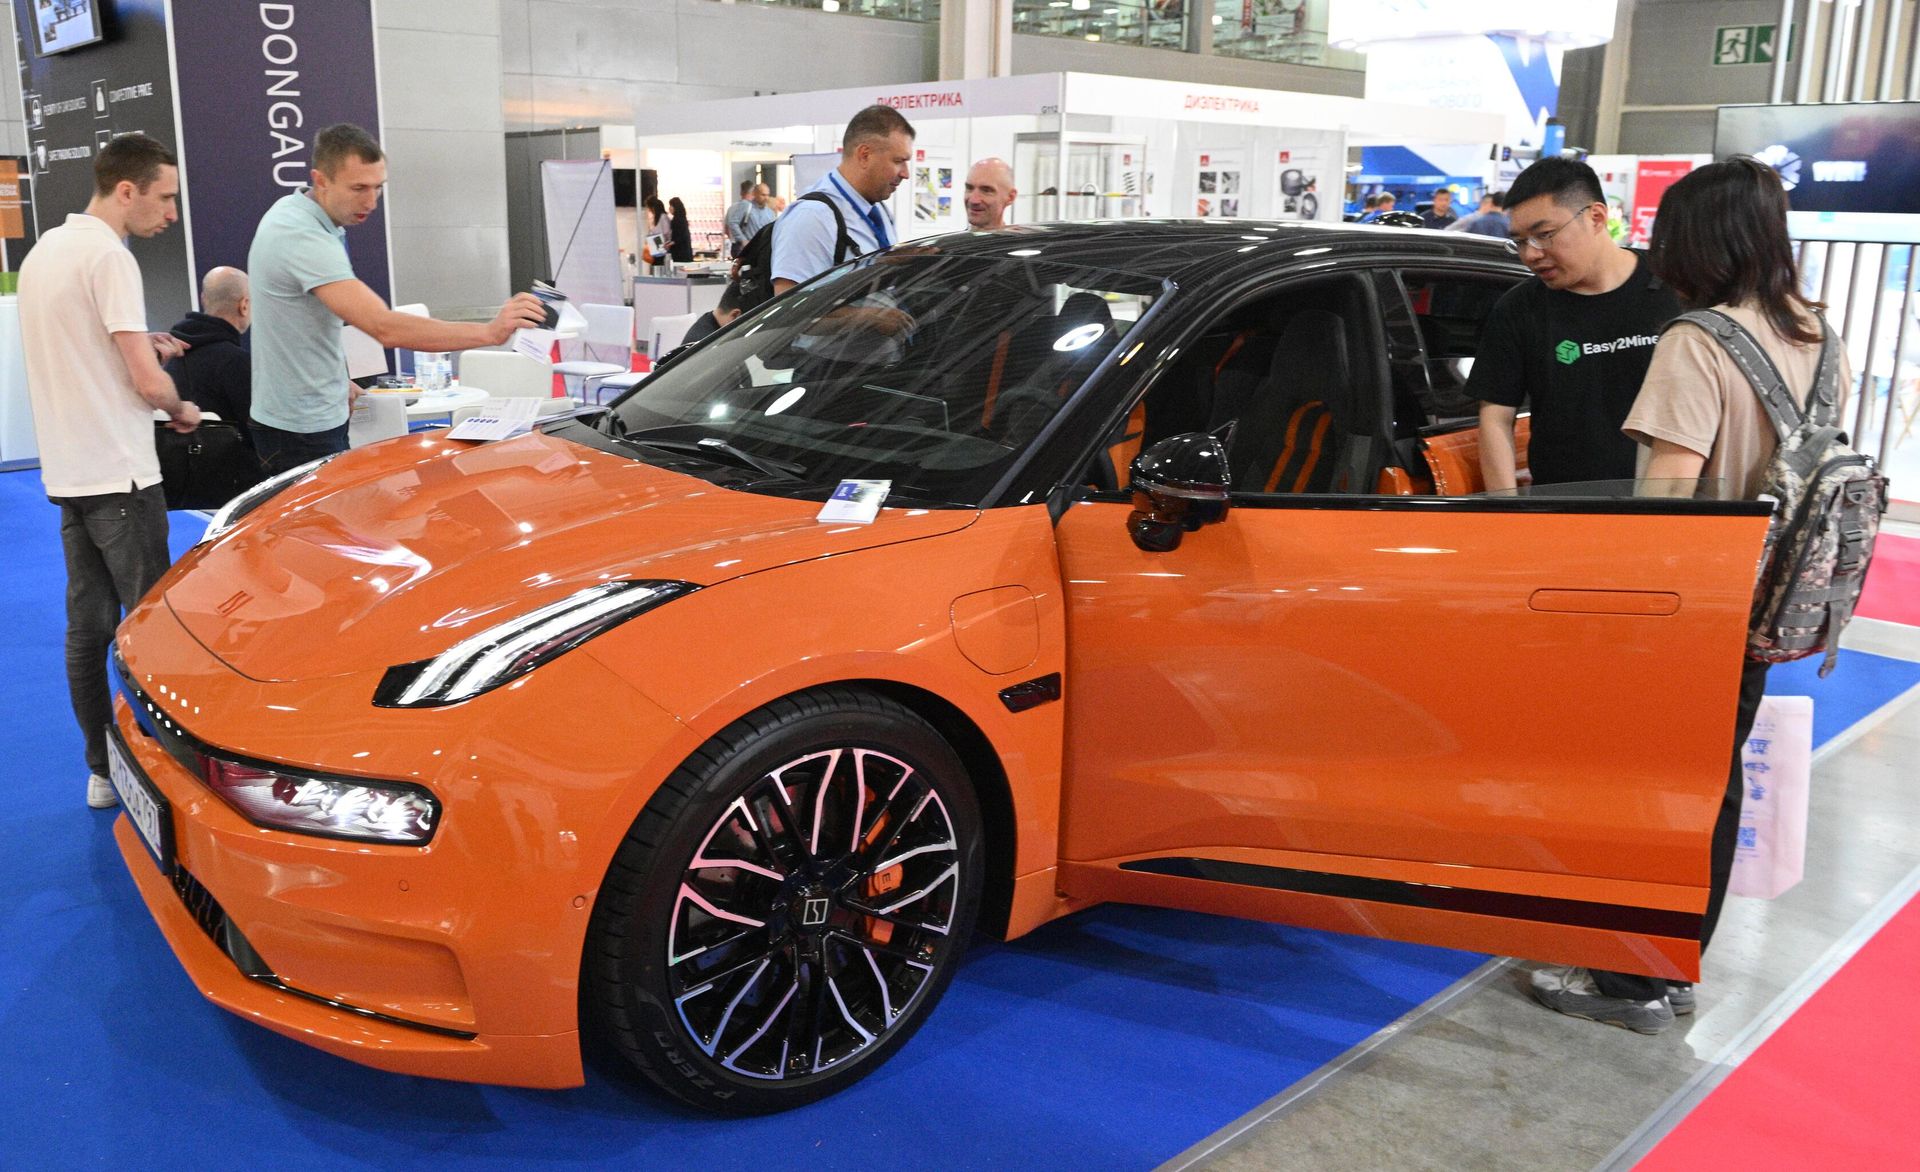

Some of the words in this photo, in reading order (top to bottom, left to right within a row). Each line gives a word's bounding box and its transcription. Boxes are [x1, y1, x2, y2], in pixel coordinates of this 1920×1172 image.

[1184, 94, 1260, 112] ДИЭЛЕКТРИКА
[1582, 335, 1659, 354] Easy2Mine
[654, 1031, 715, 1089] ZERO
